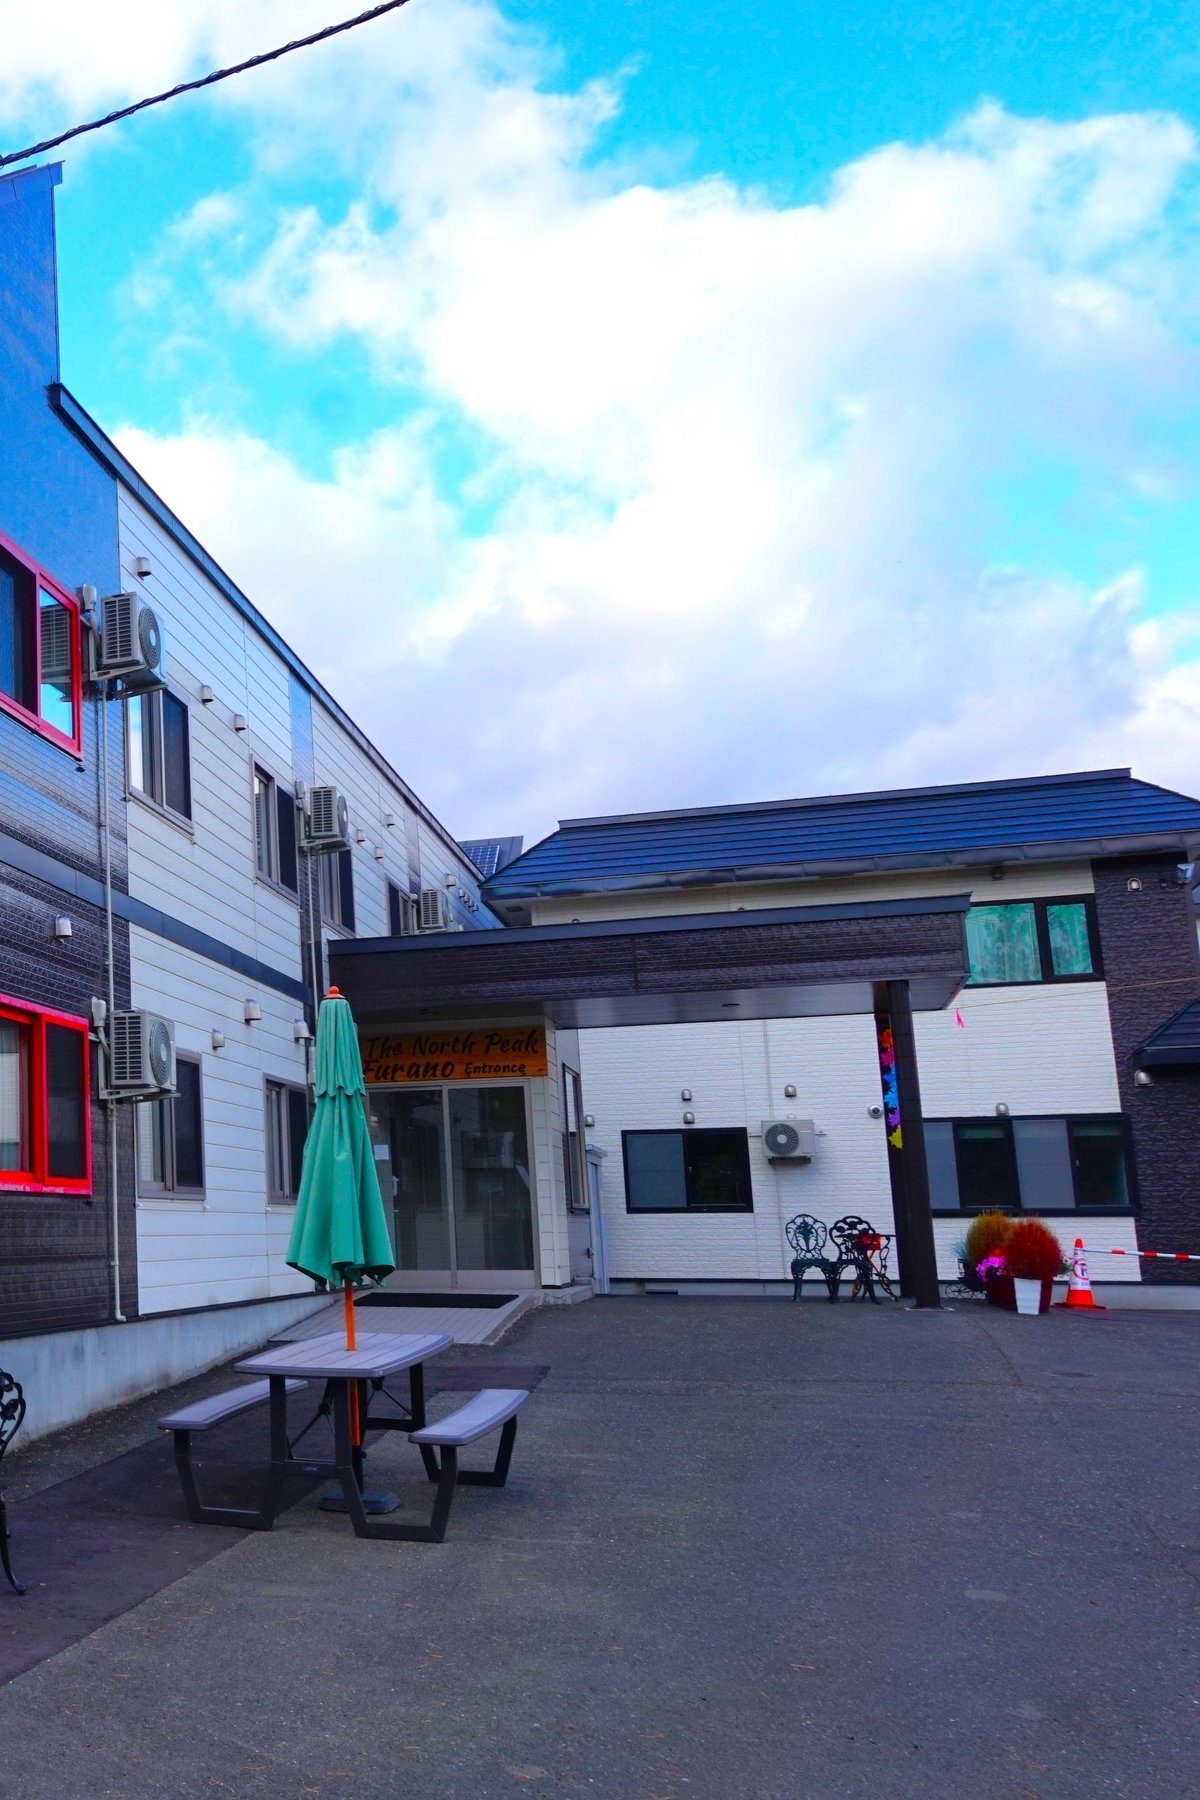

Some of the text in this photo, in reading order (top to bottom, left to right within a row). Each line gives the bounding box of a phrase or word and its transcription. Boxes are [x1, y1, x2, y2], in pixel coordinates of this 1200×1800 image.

[366, 1028, 539, 1059] The North Peak
[363, 1059, 527, 1082] Furano Entrance
